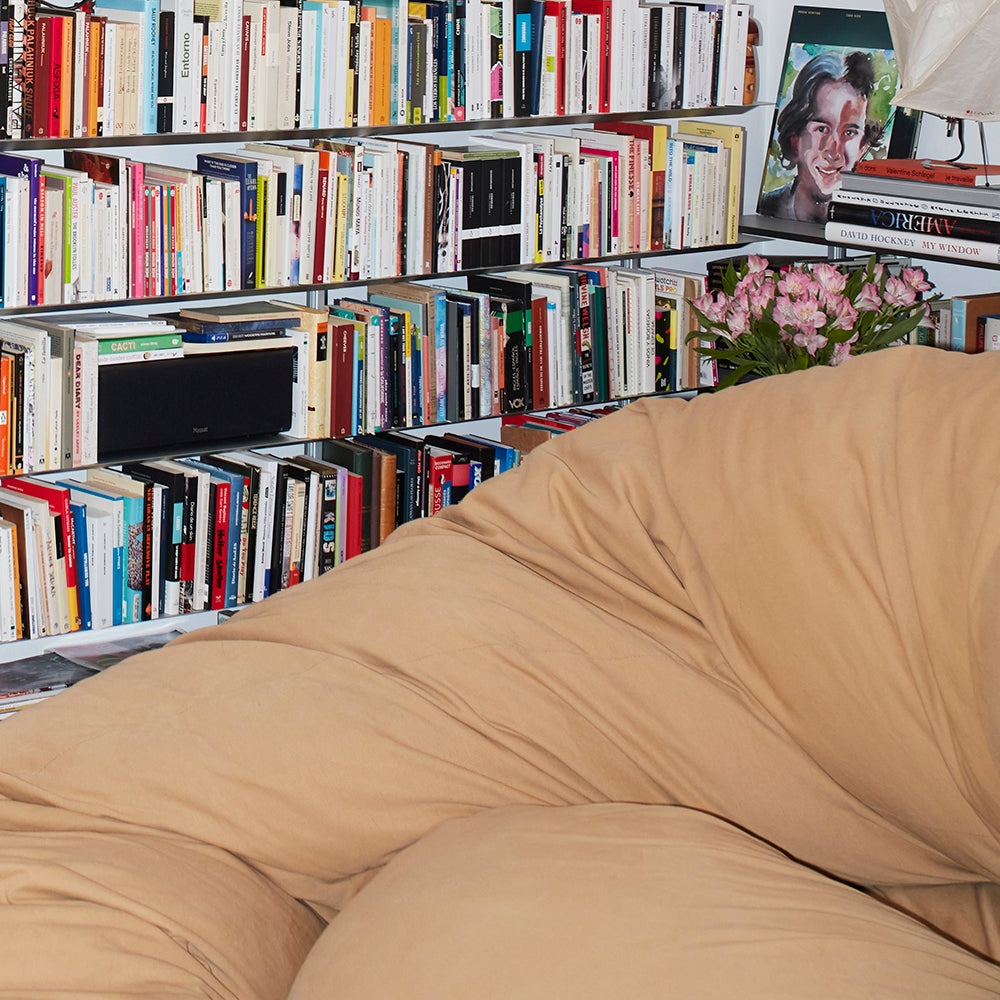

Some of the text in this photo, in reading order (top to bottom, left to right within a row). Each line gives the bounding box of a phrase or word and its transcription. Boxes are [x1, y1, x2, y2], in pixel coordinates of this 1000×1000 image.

[26, 29, 34, 84] PALAHNIUK
[181, 32, 190, 78] Entorno
[52, 63, 61, 101] ASFIXIA
[886, 167, 910, 176] Valentine
[871, 209, 957, 236] AMERICA
[840, 229, 981, 256] DAVID HOCKNEY MY WINDOW
[580, 307, 589, 340] WELSH
[111, 340, 136, 352] CACTI
[215, 529, 226, 589] Helter Skelter
